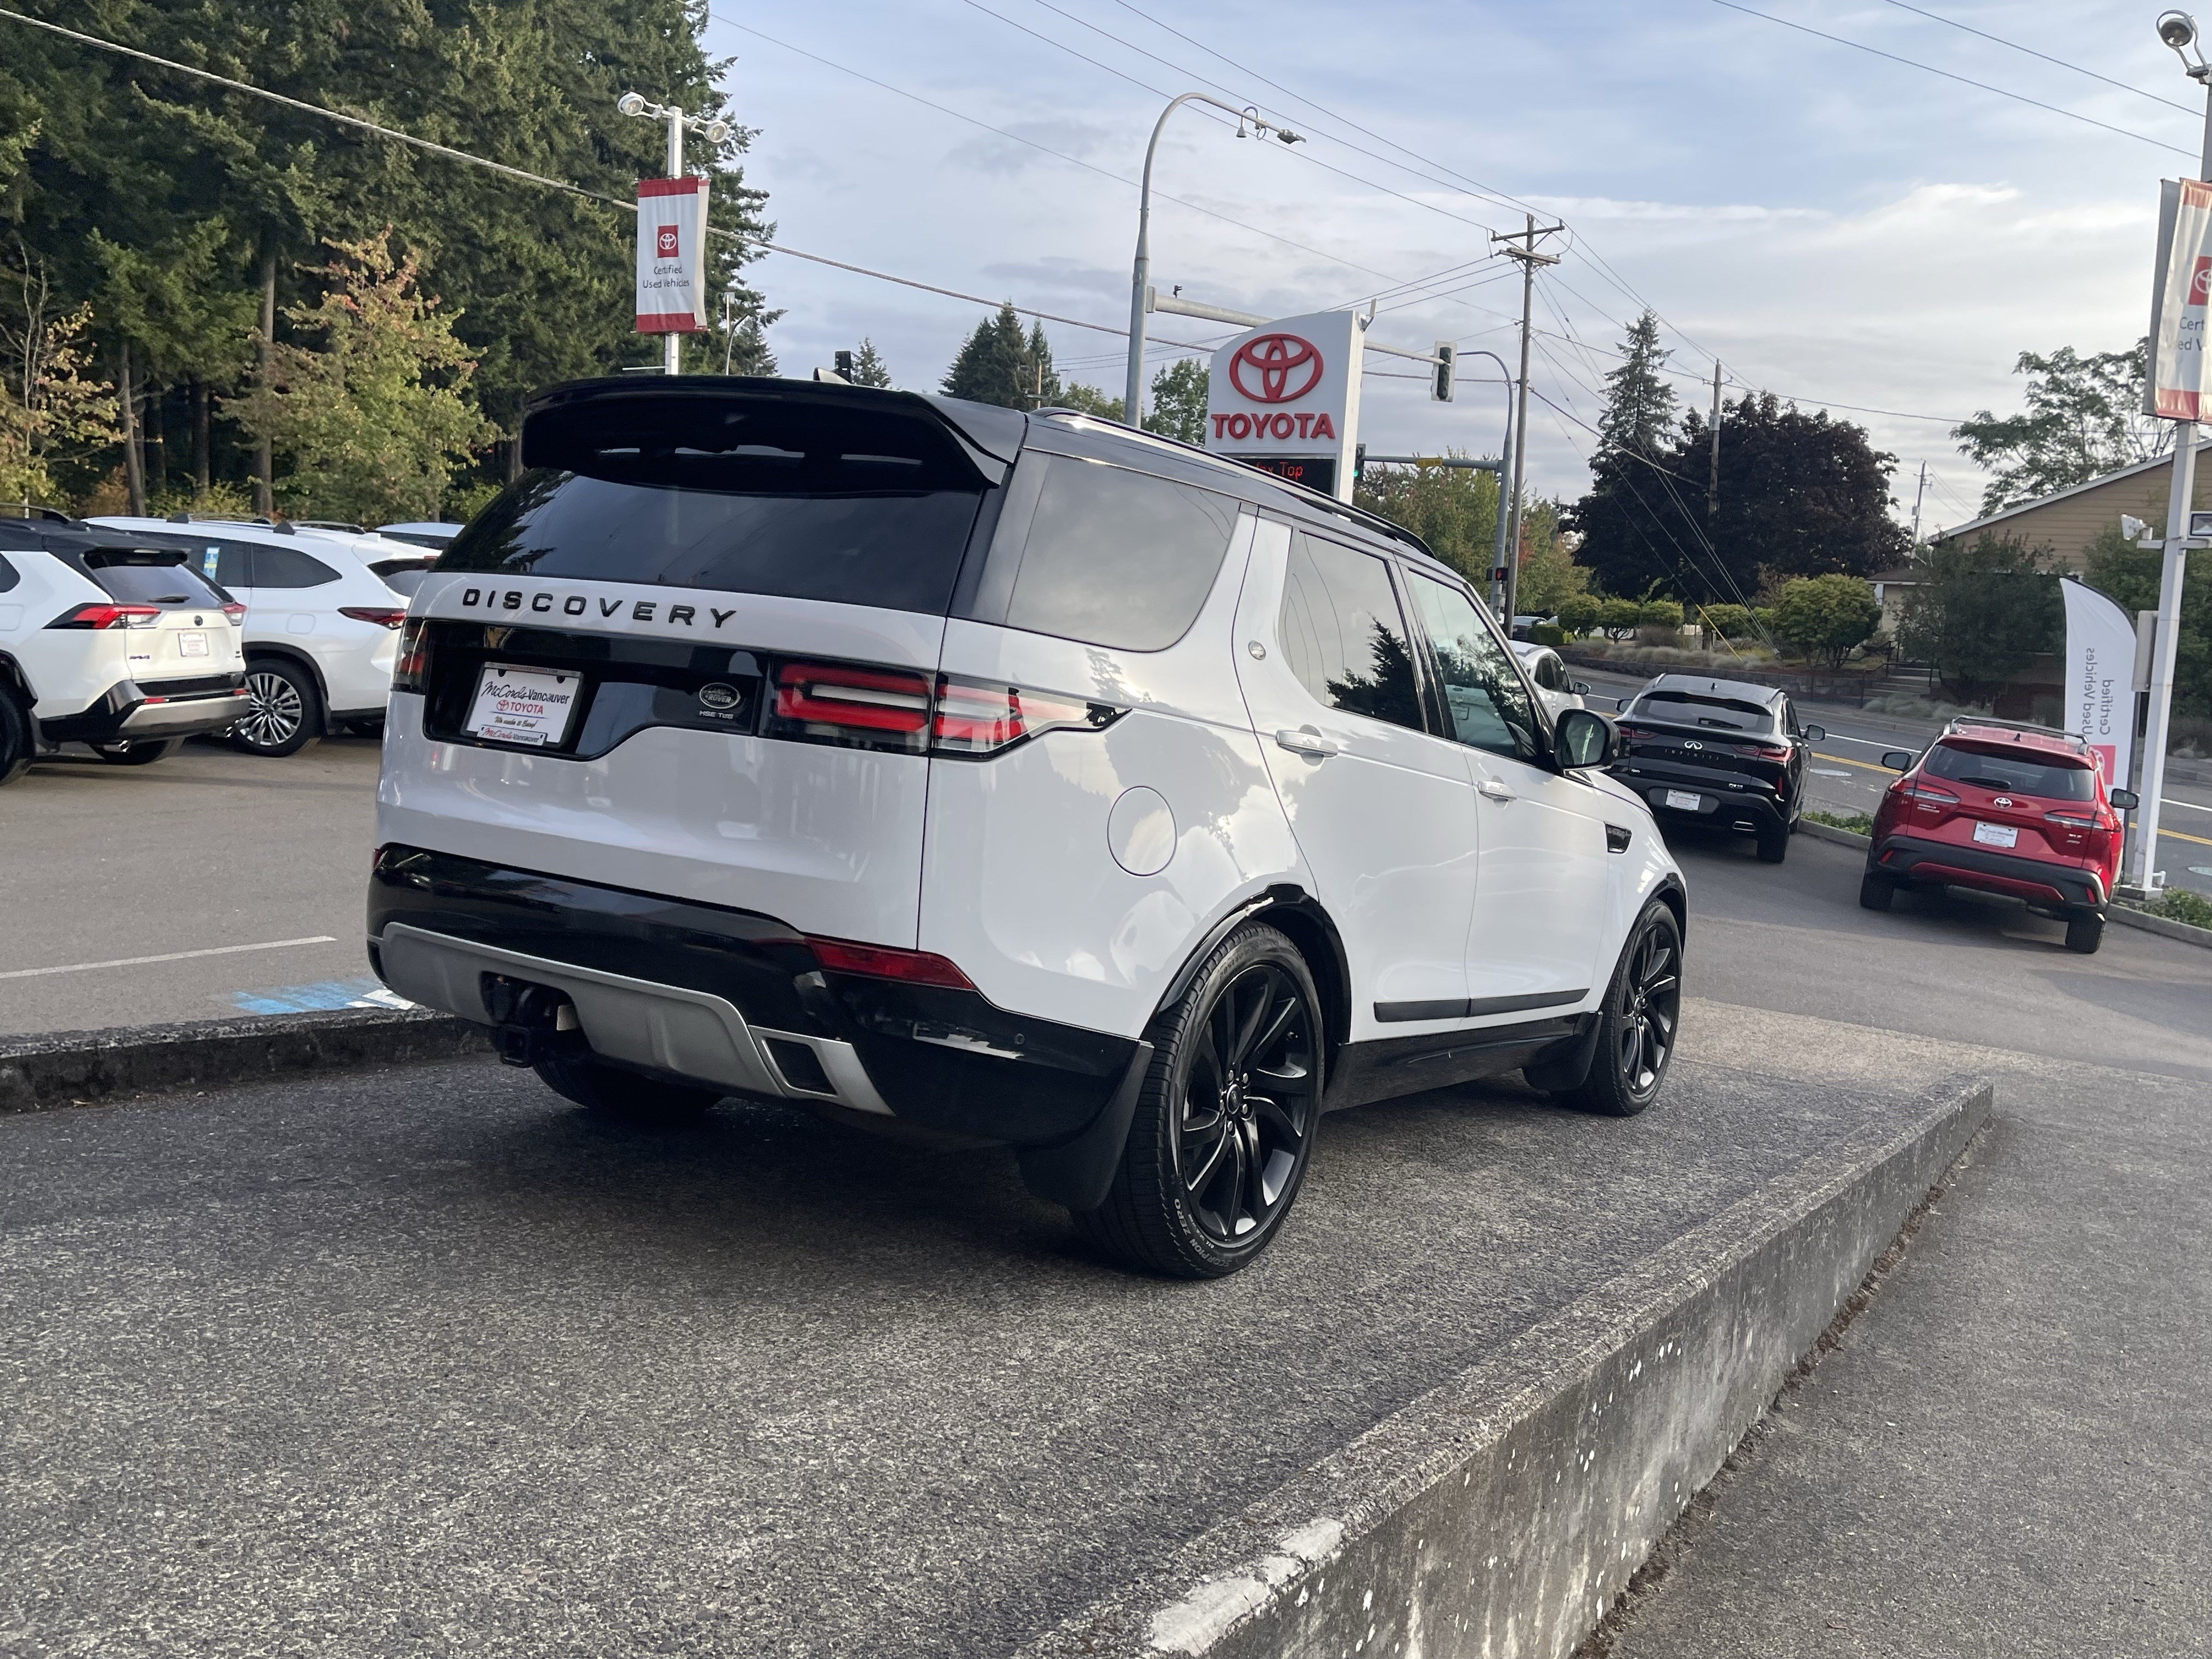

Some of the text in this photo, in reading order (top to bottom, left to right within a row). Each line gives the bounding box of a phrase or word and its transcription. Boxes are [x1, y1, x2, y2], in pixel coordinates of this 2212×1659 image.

[654, 264, 682, 274] Certified
[643, 278, 690, 289] Used Vehicles
[1211, 413, 1336, 439] TOYOTA
[1279, 460, 1304, 481] Top
[462, 588, 736, 628] DISCOVERY
[528, 689, 570, 704] Vancouver
[708, 693, 731, 703] ROVER
[510, 702, 543, 714] TOYOTA
[1174, 1198, 1192, 1235] ZERO
[1189, 1238, 1232, 1267] SCORPION
